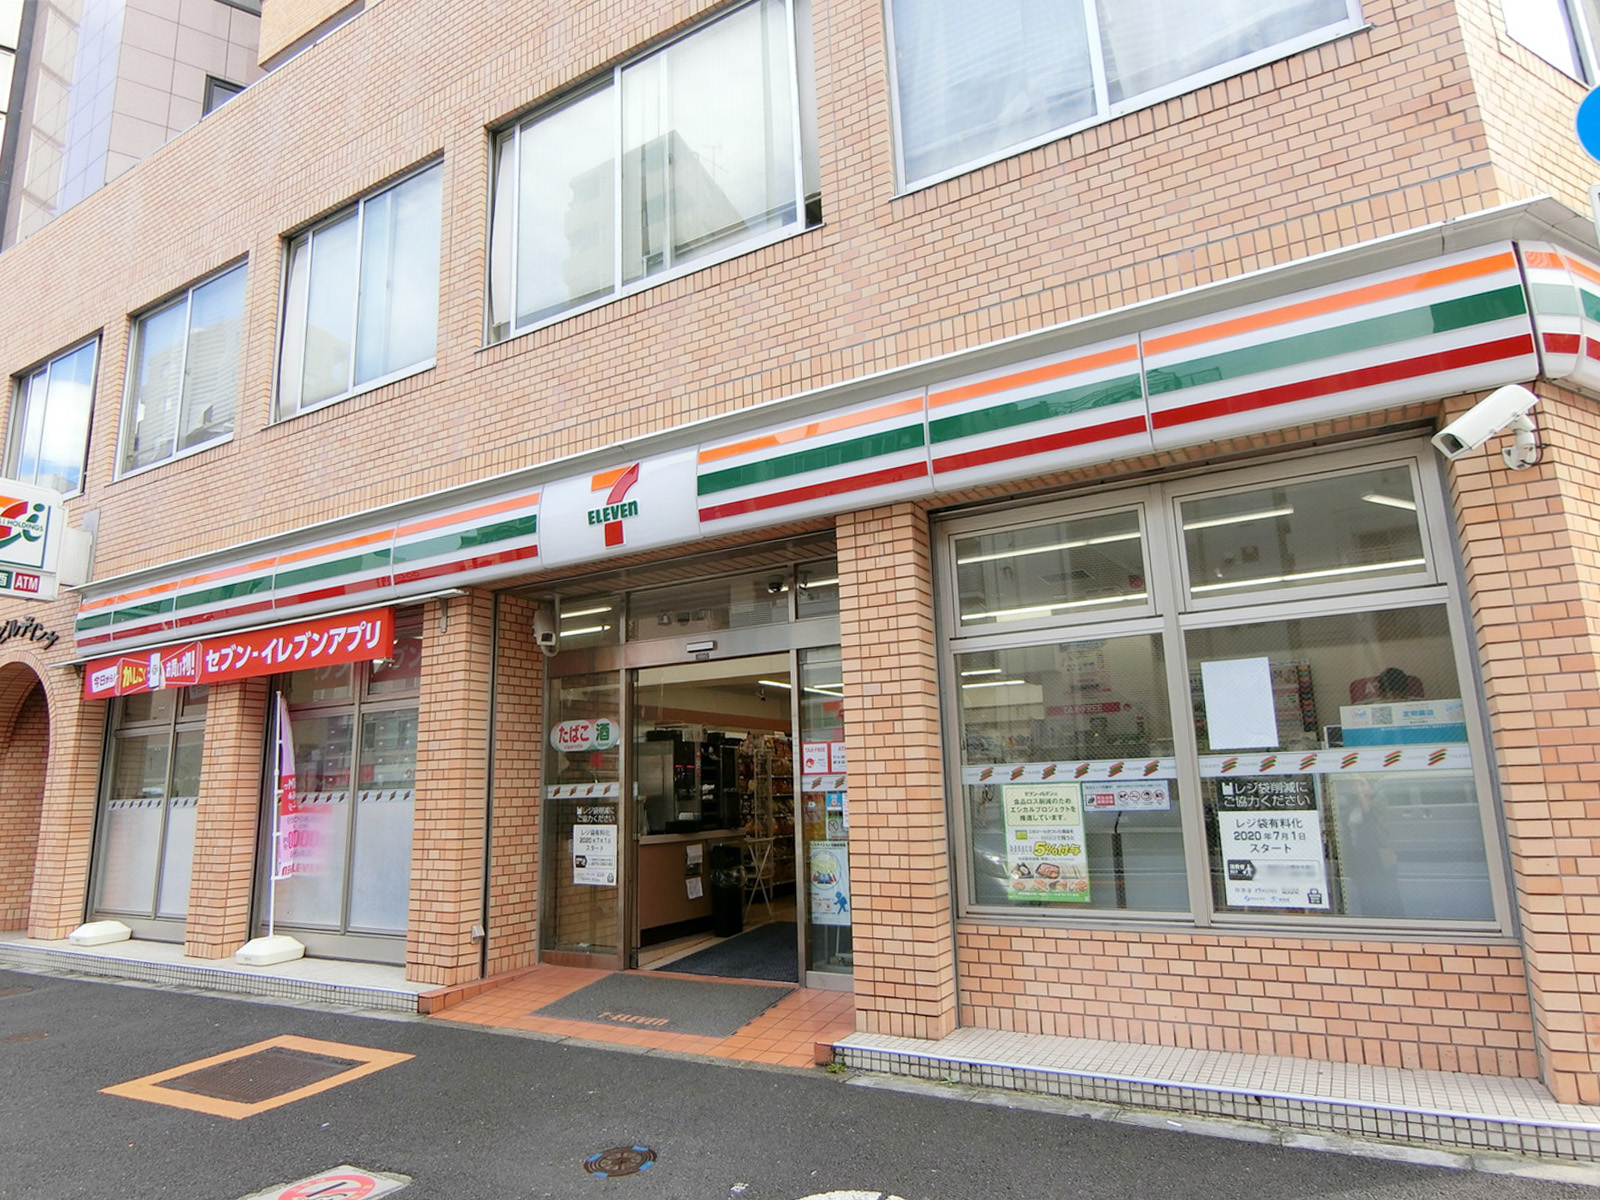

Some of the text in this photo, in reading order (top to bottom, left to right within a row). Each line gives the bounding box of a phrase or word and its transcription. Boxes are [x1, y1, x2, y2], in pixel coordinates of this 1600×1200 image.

[15, 574, 39, 591] ATM
[558, 723, 610, 744] たばこ 酒
[1235, 781, 1308, 794] レジ袋削減に
[1224, 795, 1311, 808] ご協力ください
[1236, 818, 1303, 829] レジ袋有料化
[1250, 843, 1292, 854] スタート
